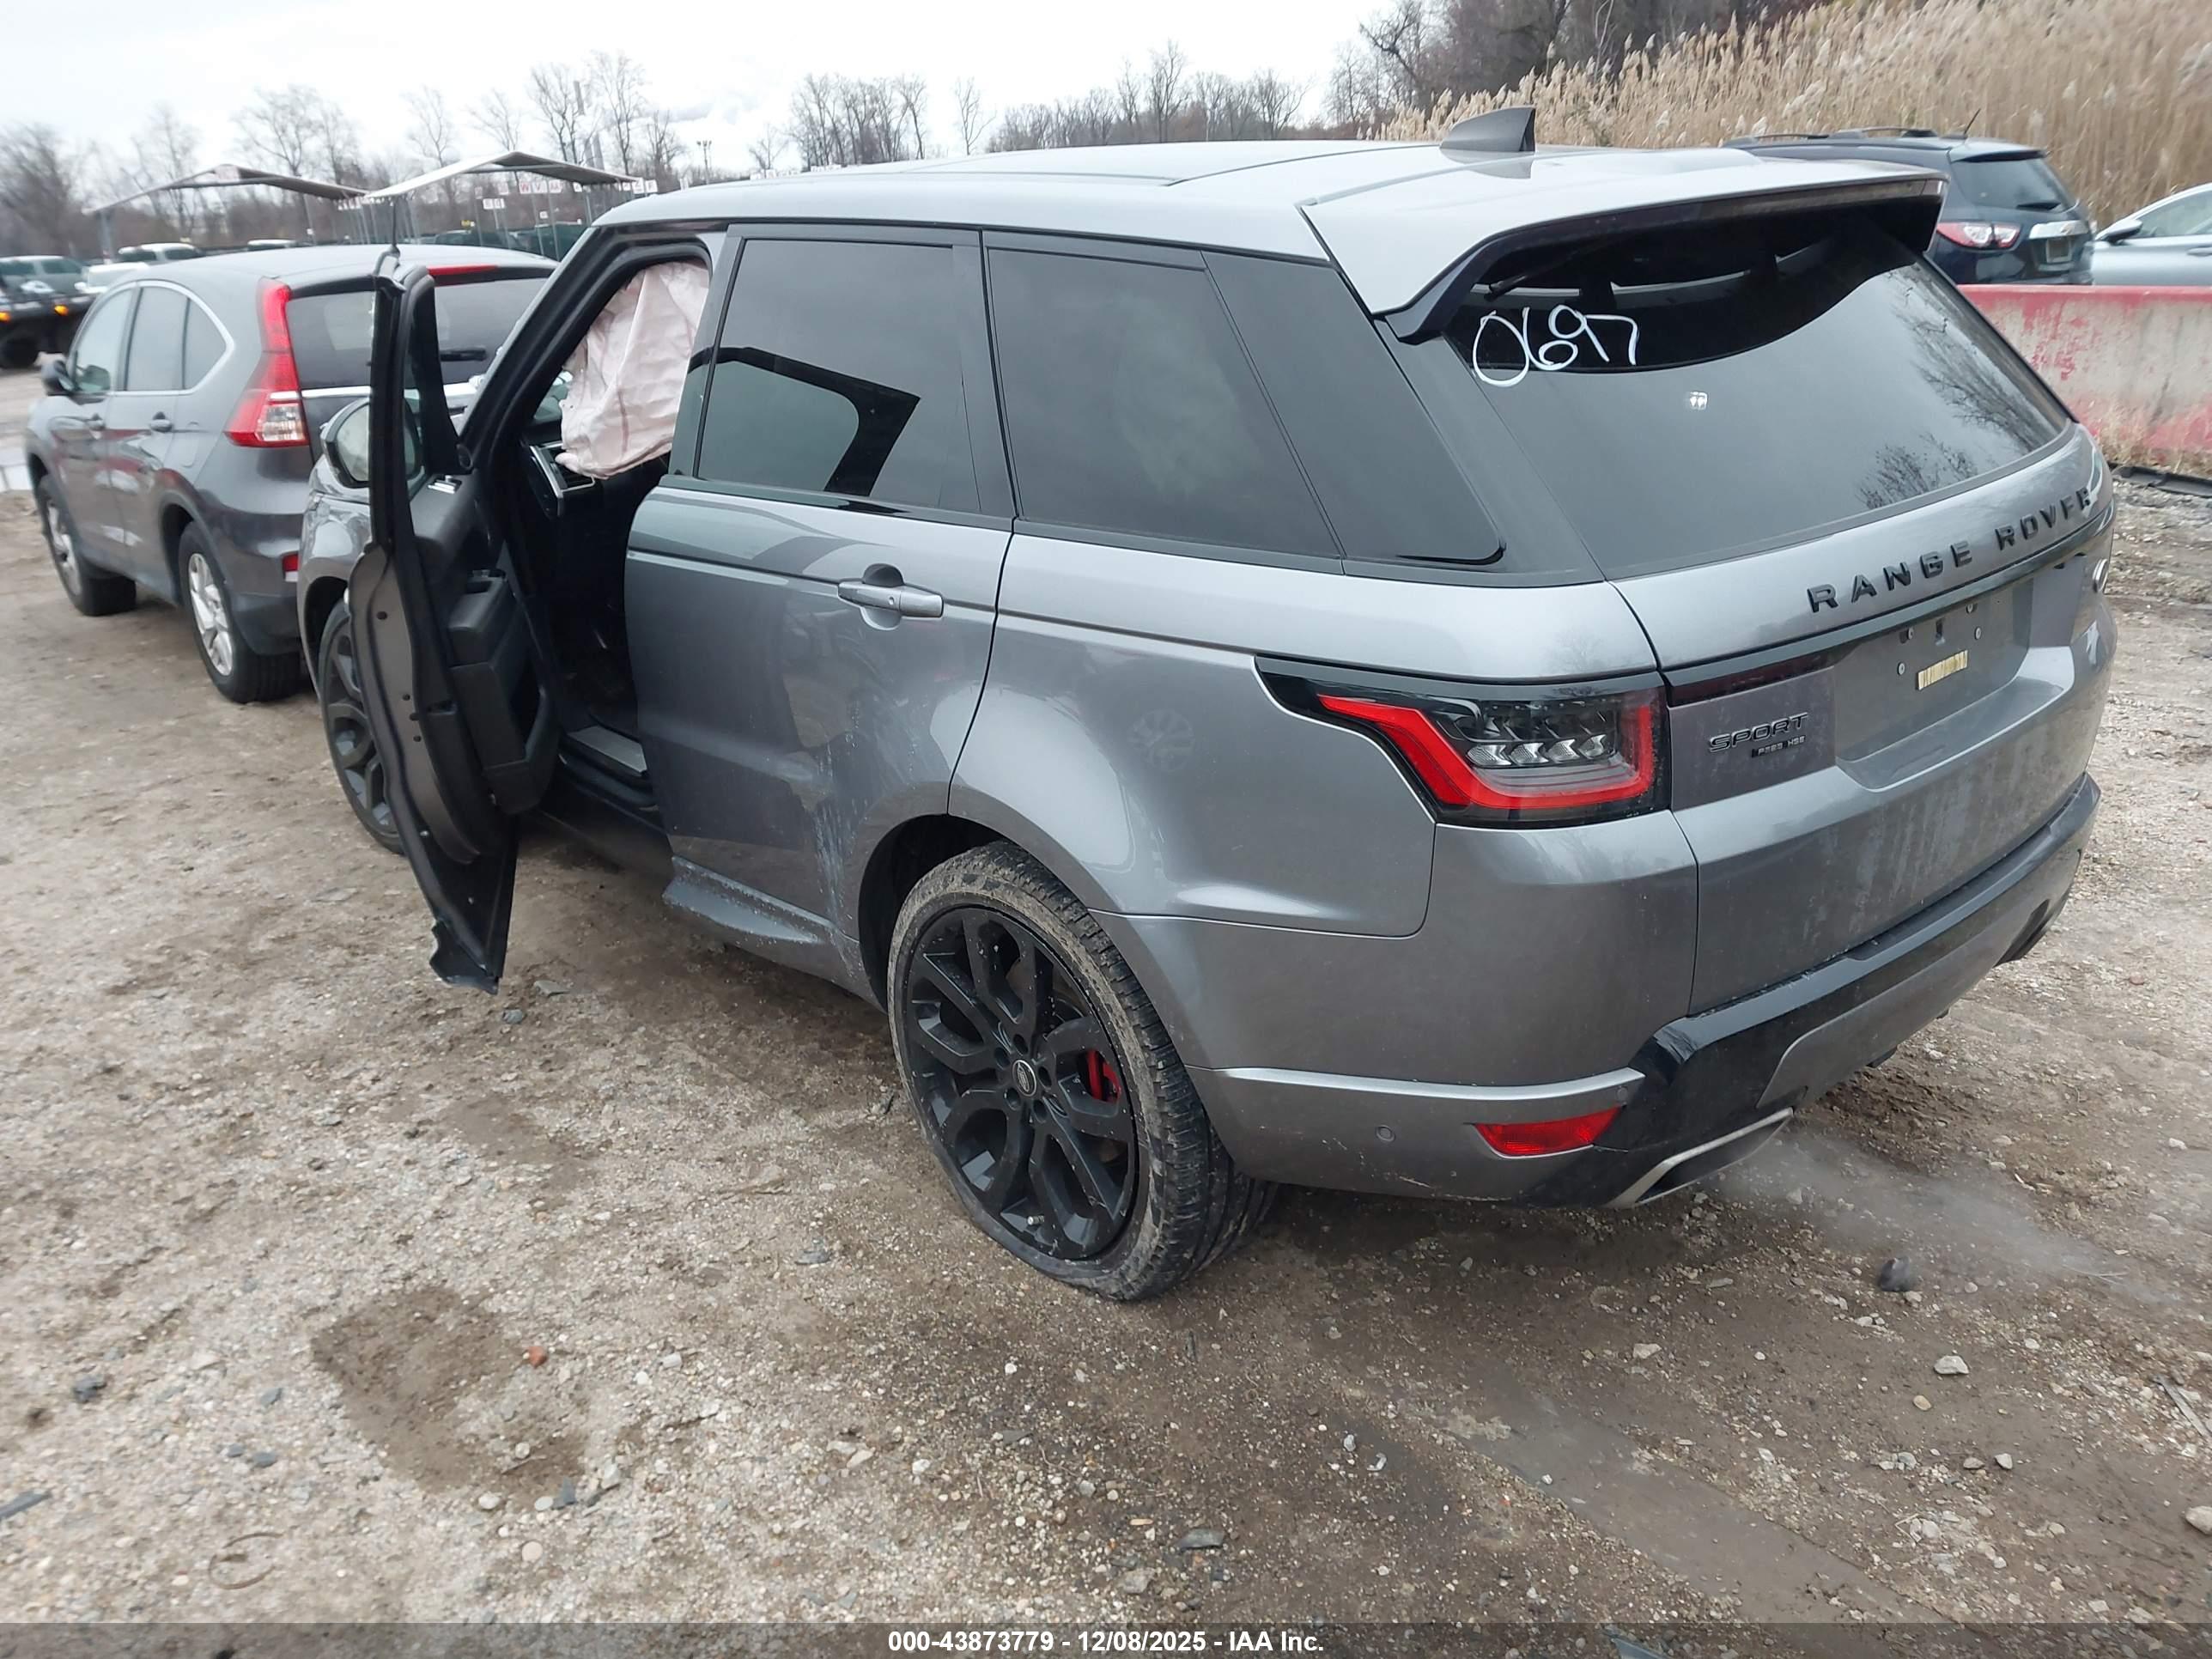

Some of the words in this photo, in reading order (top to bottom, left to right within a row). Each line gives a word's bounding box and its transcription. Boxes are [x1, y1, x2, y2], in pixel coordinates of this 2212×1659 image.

[1473, 304, 1639, 387] 0697
[1807, 539, 1972, 613] RANGE
[1994, 486, 2093, 551] ROVER
[1709, 712, 1808, 752] SPORT
